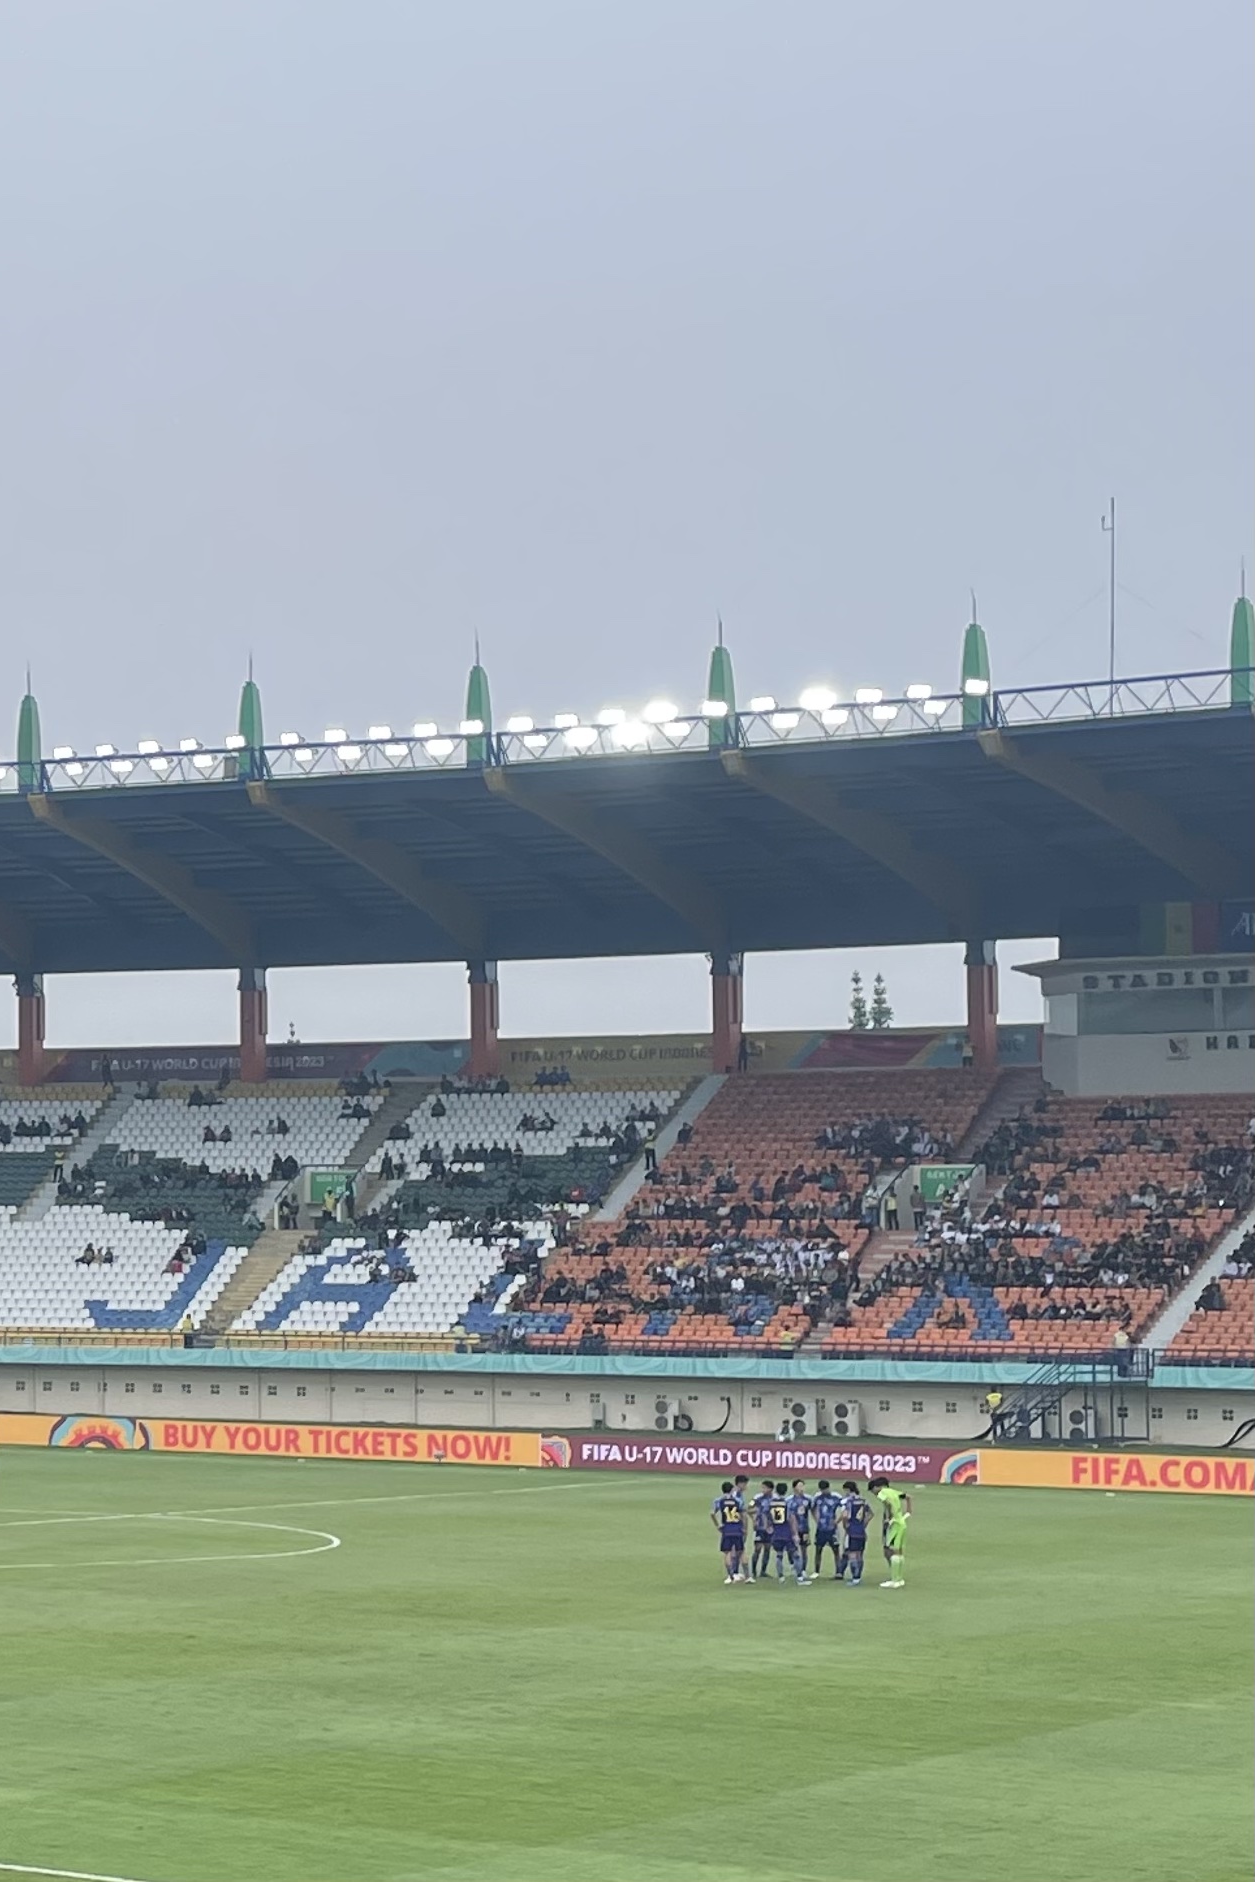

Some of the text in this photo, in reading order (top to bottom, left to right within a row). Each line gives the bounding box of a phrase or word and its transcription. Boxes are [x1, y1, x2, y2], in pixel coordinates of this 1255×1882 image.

[1082, 969, 1249, 989] STADION
[151, 1057, 199, 1070] WORLD
[163, 1423, 512, 1461] BUY YOUR TICKETS NOW!
[581, 1443, 622, 1461] FIFA
[624, 1445, 663, 1464] U-17
[665, 1447, 733, 1466] WORLD
[736, 1449, 772, 1467] CUP
[776, 1451, 873, 1479] INDONESIA
[1071, 1456, 1255, 1492] FIFA.COM
